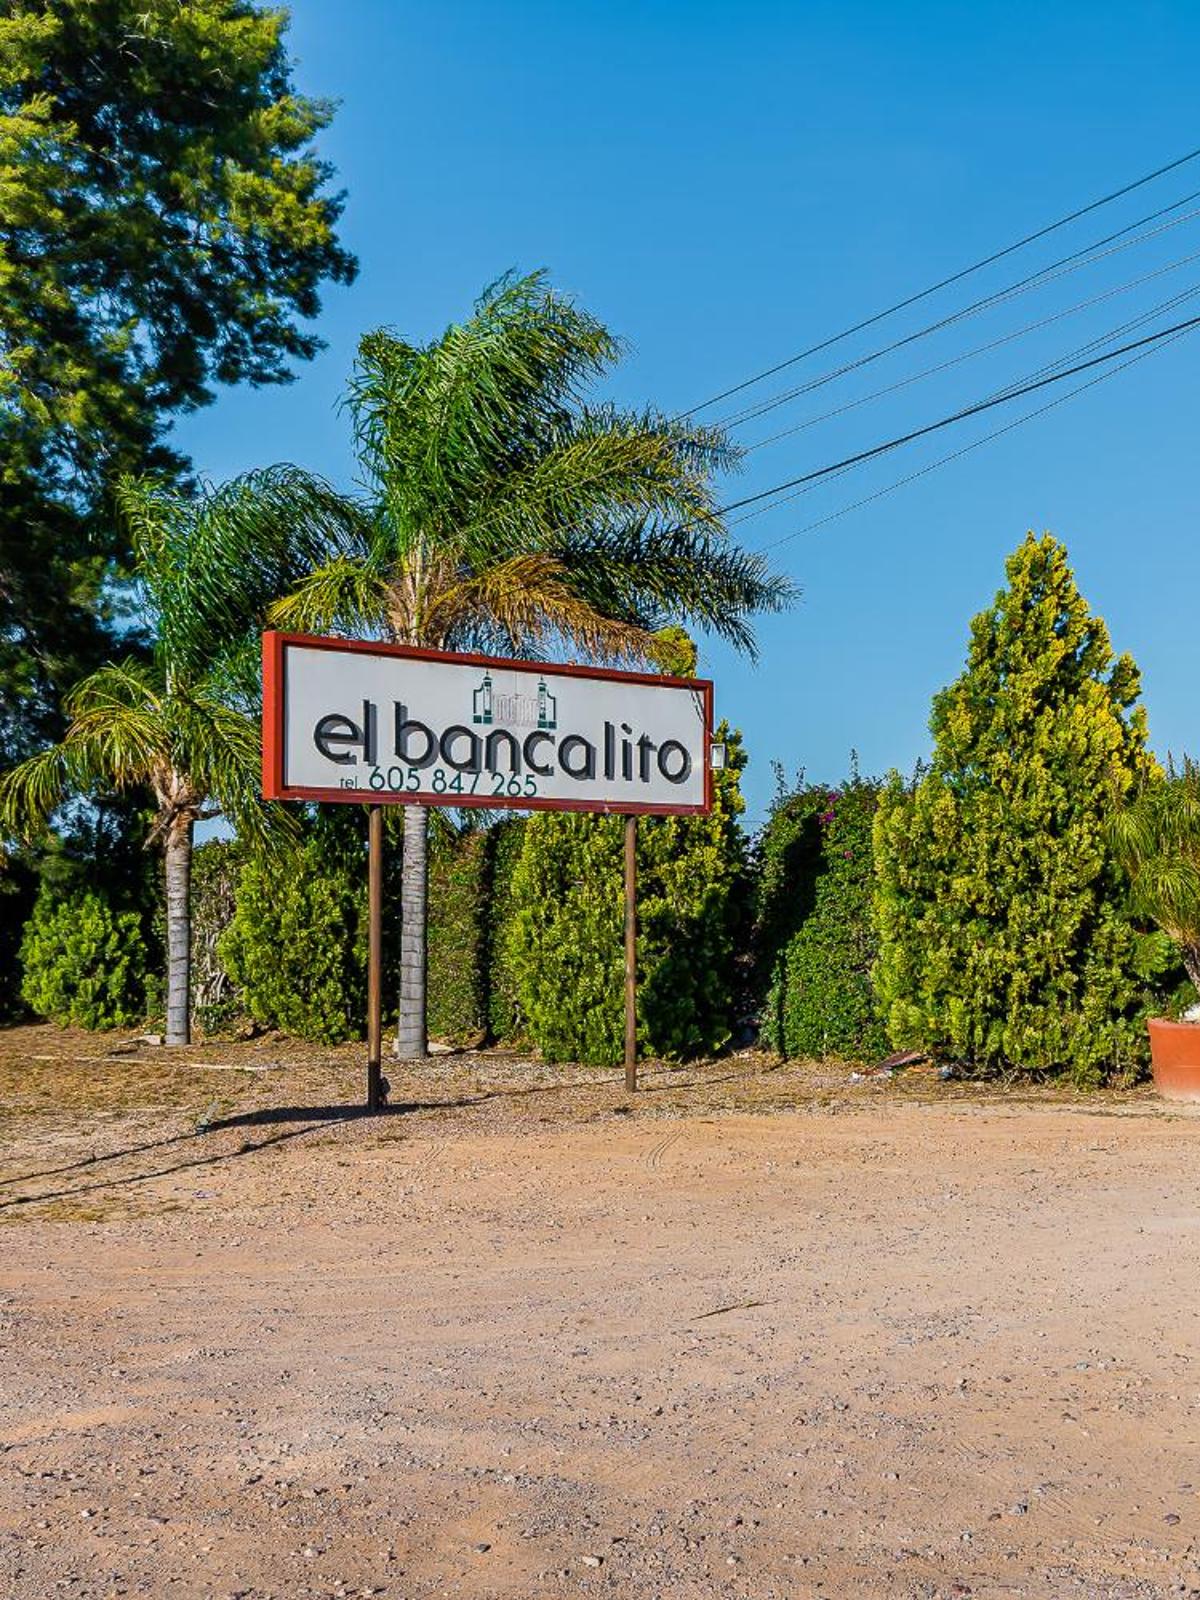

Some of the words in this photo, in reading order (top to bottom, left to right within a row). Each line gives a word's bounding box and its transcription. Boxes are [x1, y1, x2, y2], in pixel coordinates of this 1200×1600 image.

[313, 699, 377, 765] el
[393, 701, 692, 784] bancalito
[340, 776, 362, 790] tel.
[369, 766, 421, 792] 605
[432, 769, 480, 794] 847
[491, 772, 537, 797] 265
